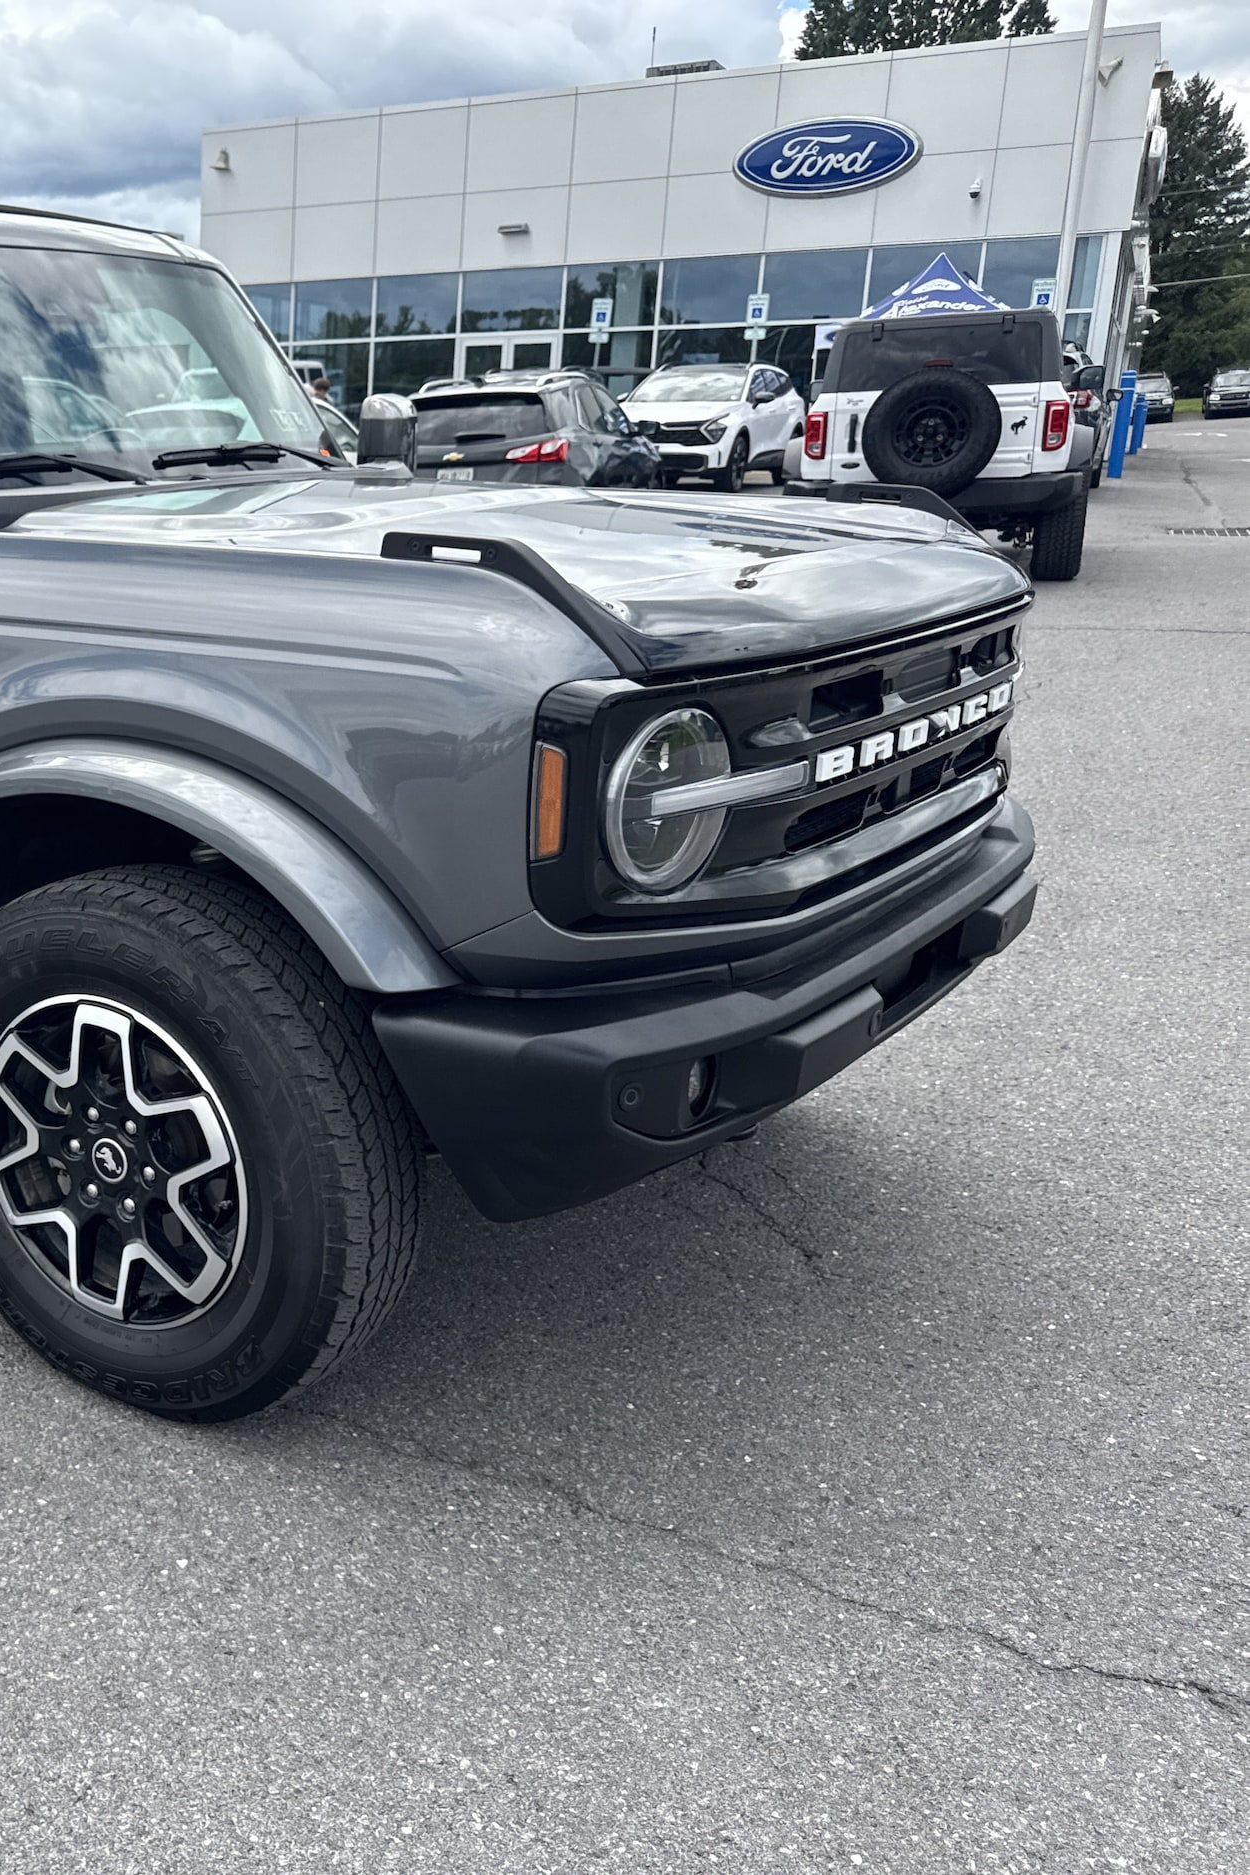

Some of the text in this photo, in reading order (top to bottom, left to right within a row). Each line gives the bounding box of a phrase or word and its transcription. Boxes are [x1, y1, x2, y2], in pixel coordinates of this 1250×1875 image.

[770, 133, 878, 180] Ford
[879, 300, 986, 318] Alexander
[814, 681, 1013, 783] BRONCO
